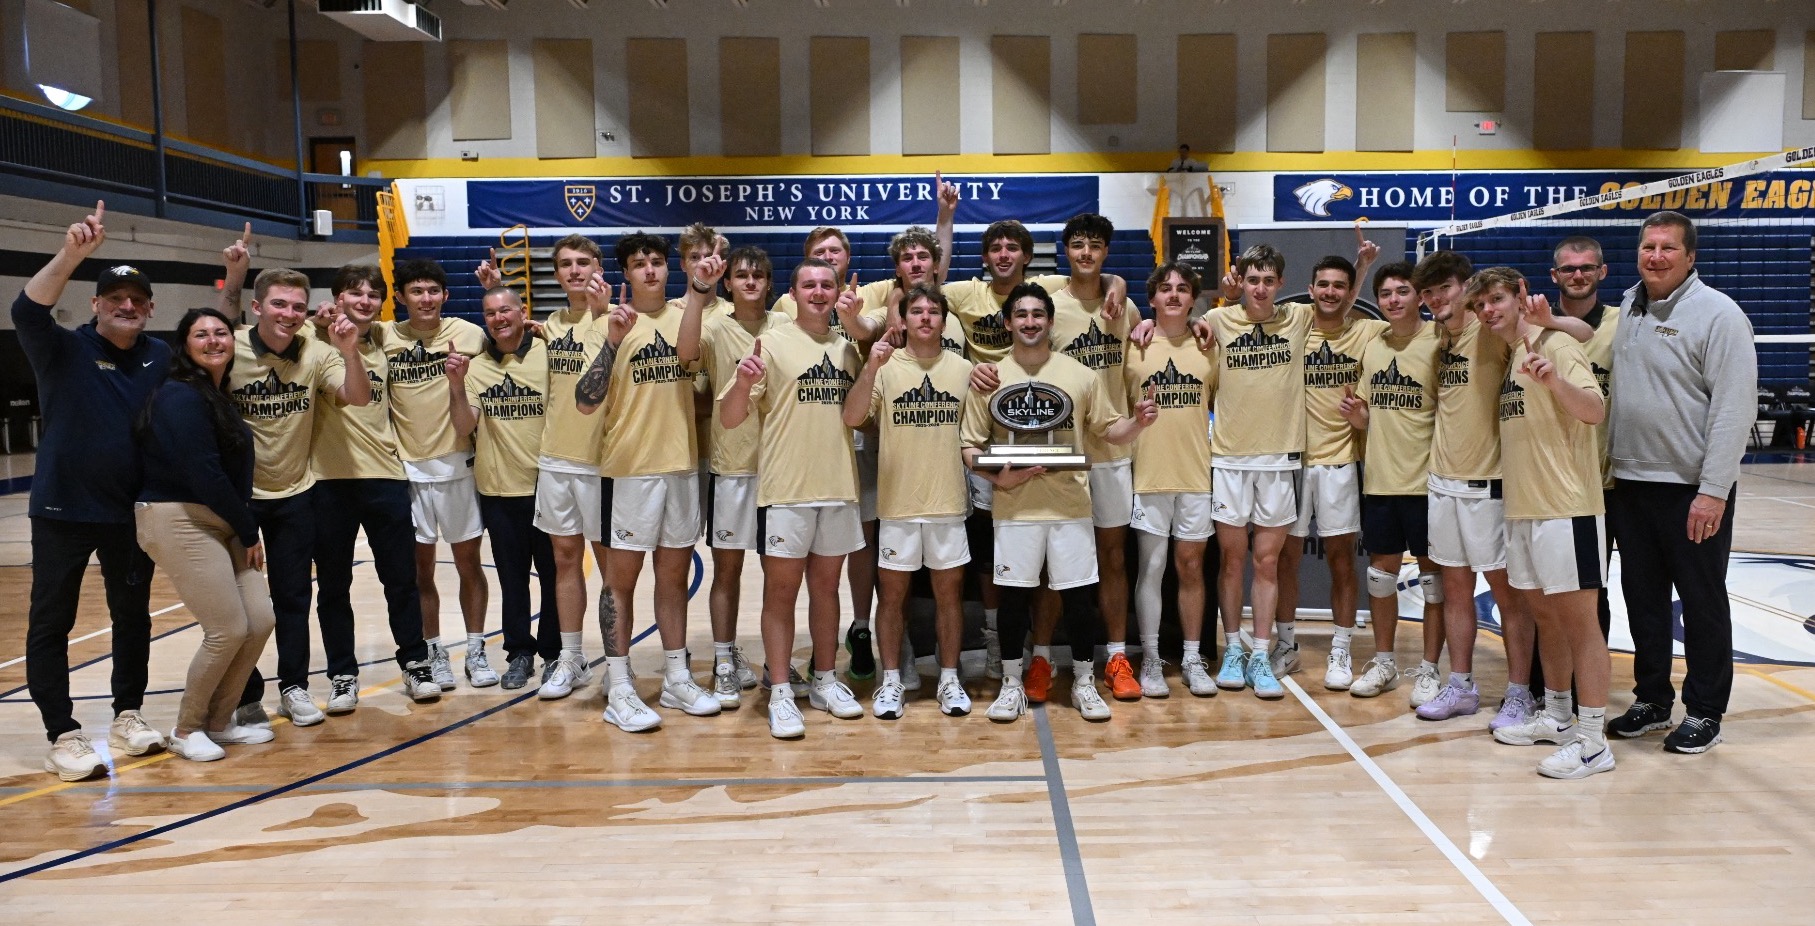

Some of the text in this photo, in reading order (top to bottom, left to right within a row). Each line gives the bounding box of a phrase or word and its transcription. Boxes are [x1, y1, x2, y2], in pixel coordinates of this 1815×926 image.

[1668, 168, 1724, 188] GOLDEN EAGLES
[610, 182, 1004, 206] ST. JOSEPH'S UNIVERITY
[1359, 187, 1455, 208] HOME
[1469, 186, 1509, 207] OF
[1524, 186, 1587, 207] THE
[745, 206, 870, 220] NEW YORK
[630, 357, 657, 368] SKYLINE
[1227, 350, 1291, 368] CHAMPIONS
[485, 403, 544, 417] HAMPIONS
[893, 410, 958, 424] CHAMPIONS
[1008, 408, 1055, 416] SKYLINE
